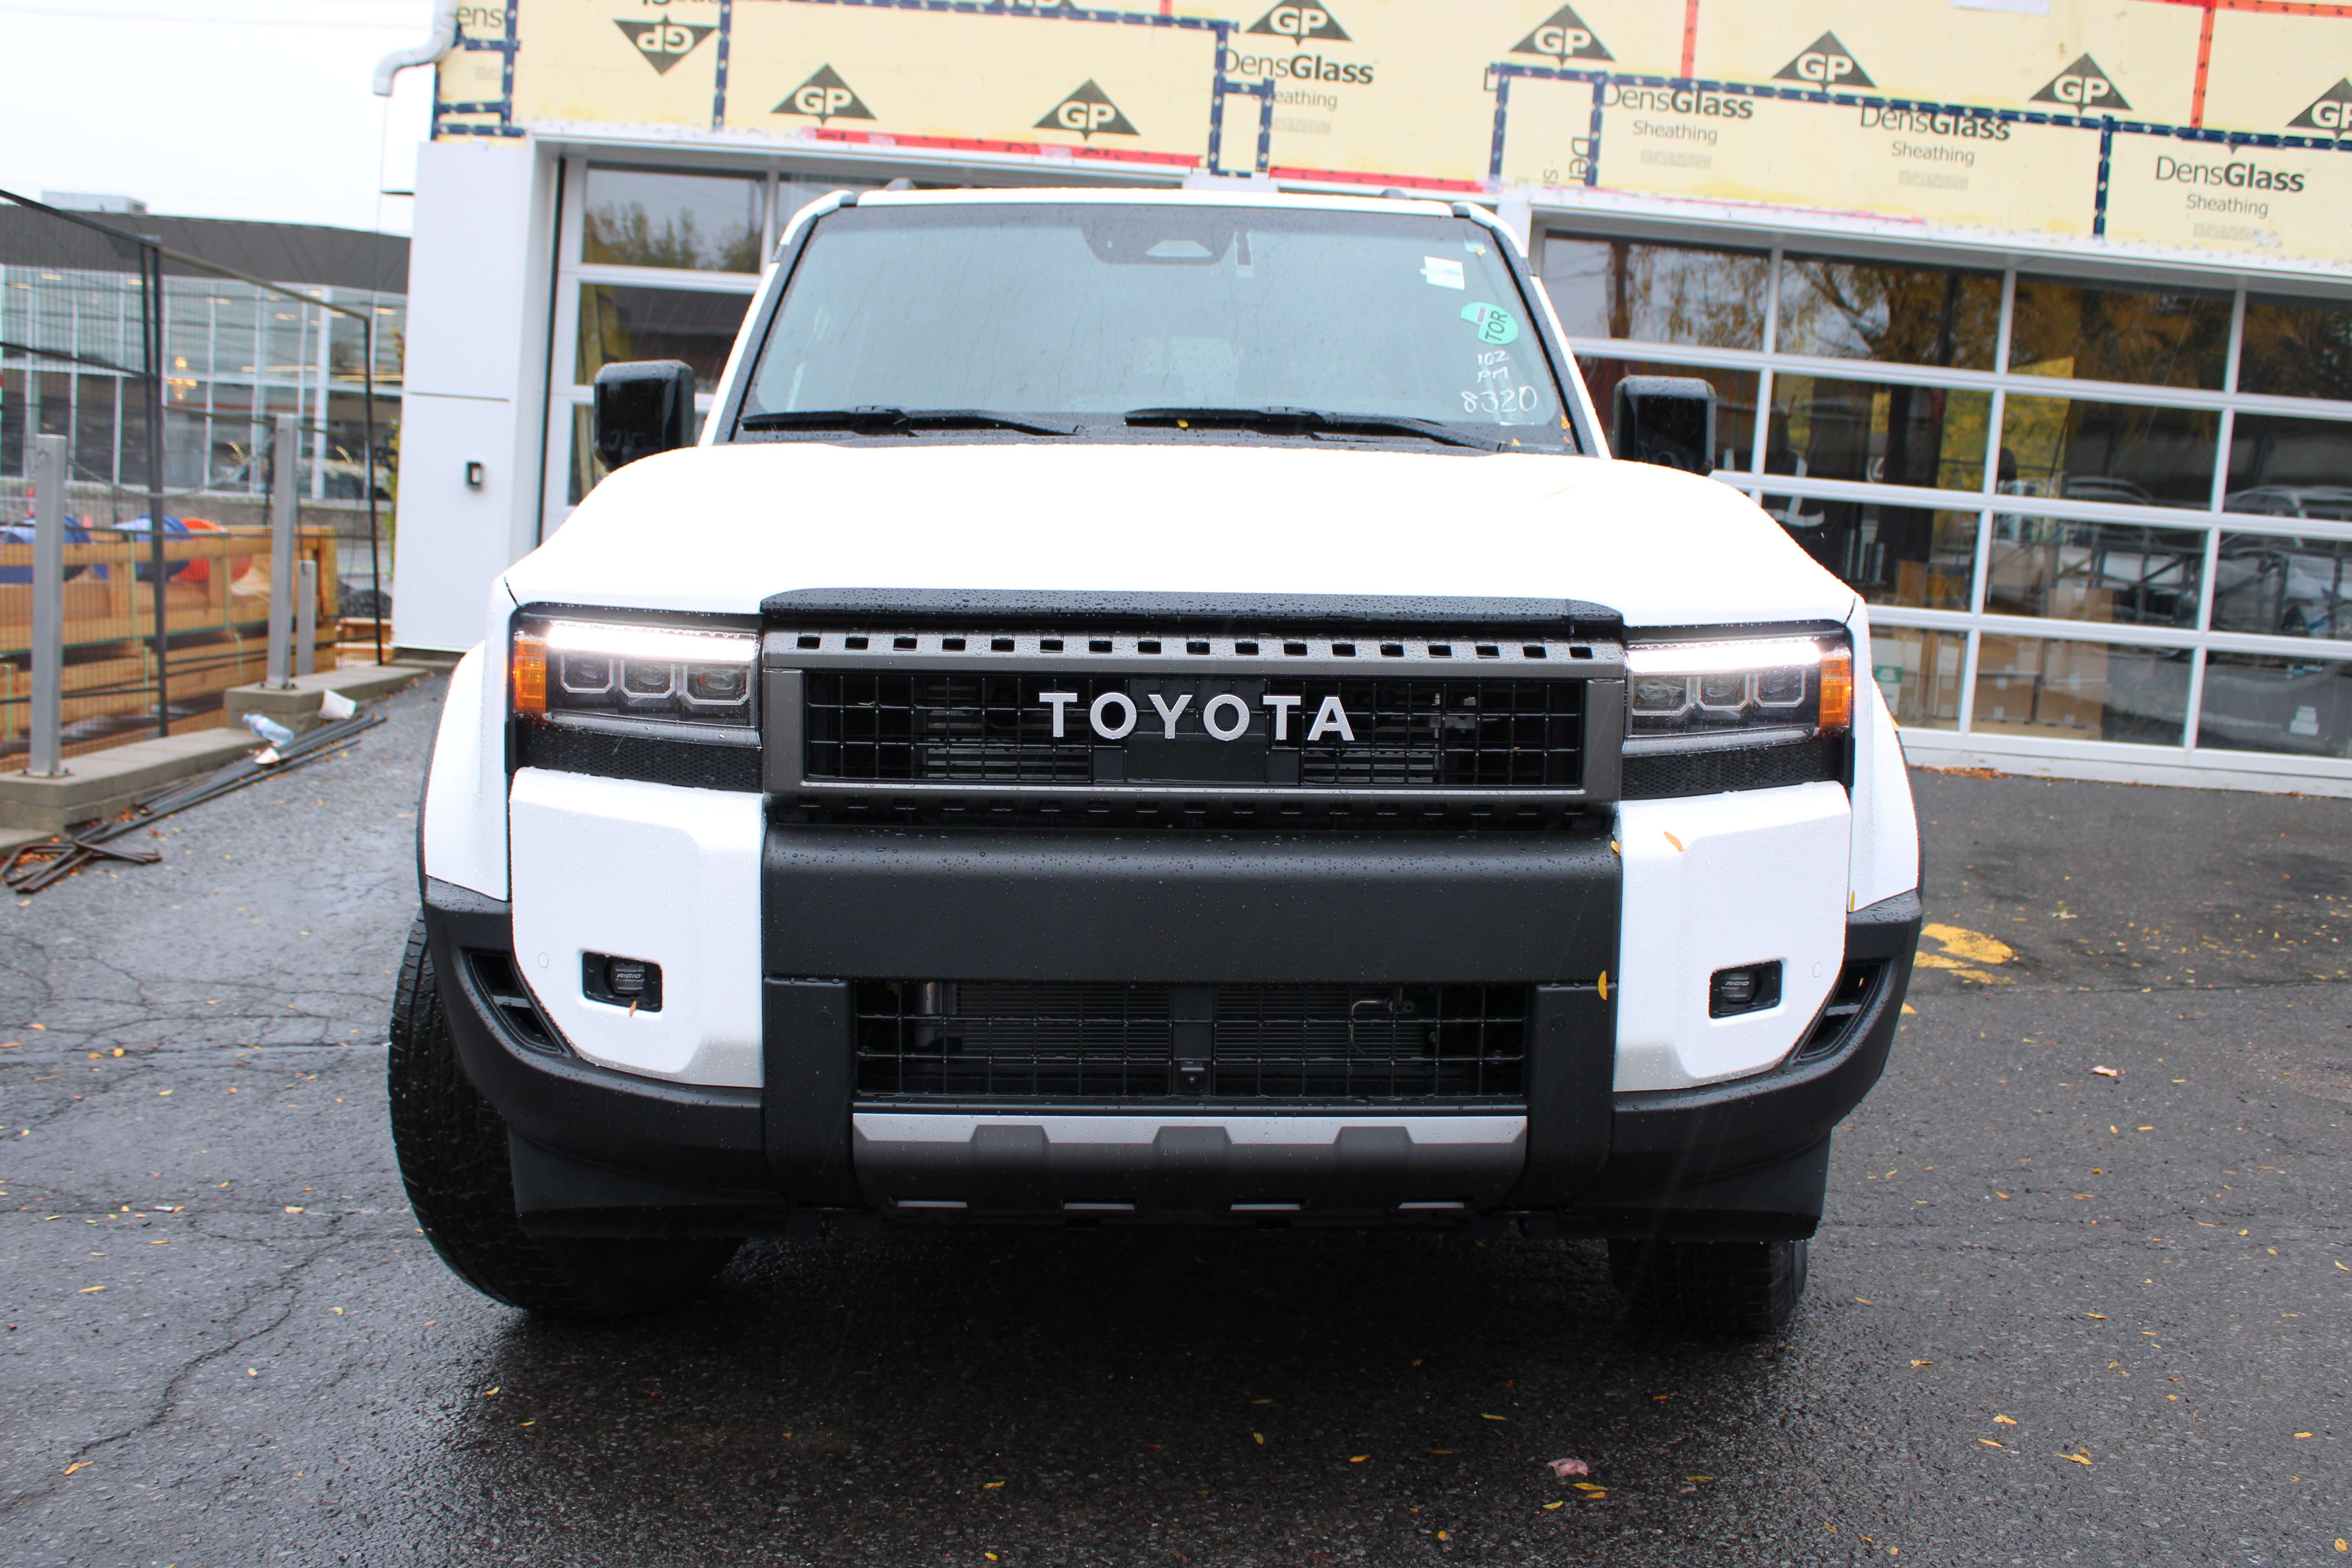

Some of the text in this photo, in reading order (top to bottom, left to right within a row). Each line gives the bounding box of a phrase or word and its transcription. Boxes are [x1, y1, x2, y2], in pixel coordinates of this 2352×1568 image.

[1269, 6, 1329, 36] GP
[637, 24, 694, 54] GP
[1534, 25, 1592, 56] GP
[1225, 47, 1374, 84] DensGlass
[1796, 52, 1853, 82] GP
[794, 86, 853, 116] GP
[1252, 89, 1338, 111] eathing
[1602, 82, 1754, 119] DensGlass
[2052, 74, 2110, 105] GP
[1057, 100, 1116, 130] GP
[1860, 106, 2011, 141] DensGlass
[1633, 119, 1718, 145] Sheathing
[1892, 140, 1976, 168] Sheathing
[2156, 155, 2305, 192] DensGlass
[2186, 193, 2269, 220] Sheathing
[1485, 310, 1509, 341] TOR
[1461, 385, 1537, 413] 8320
[1039, 692, 1355, 742] TOYOTA
